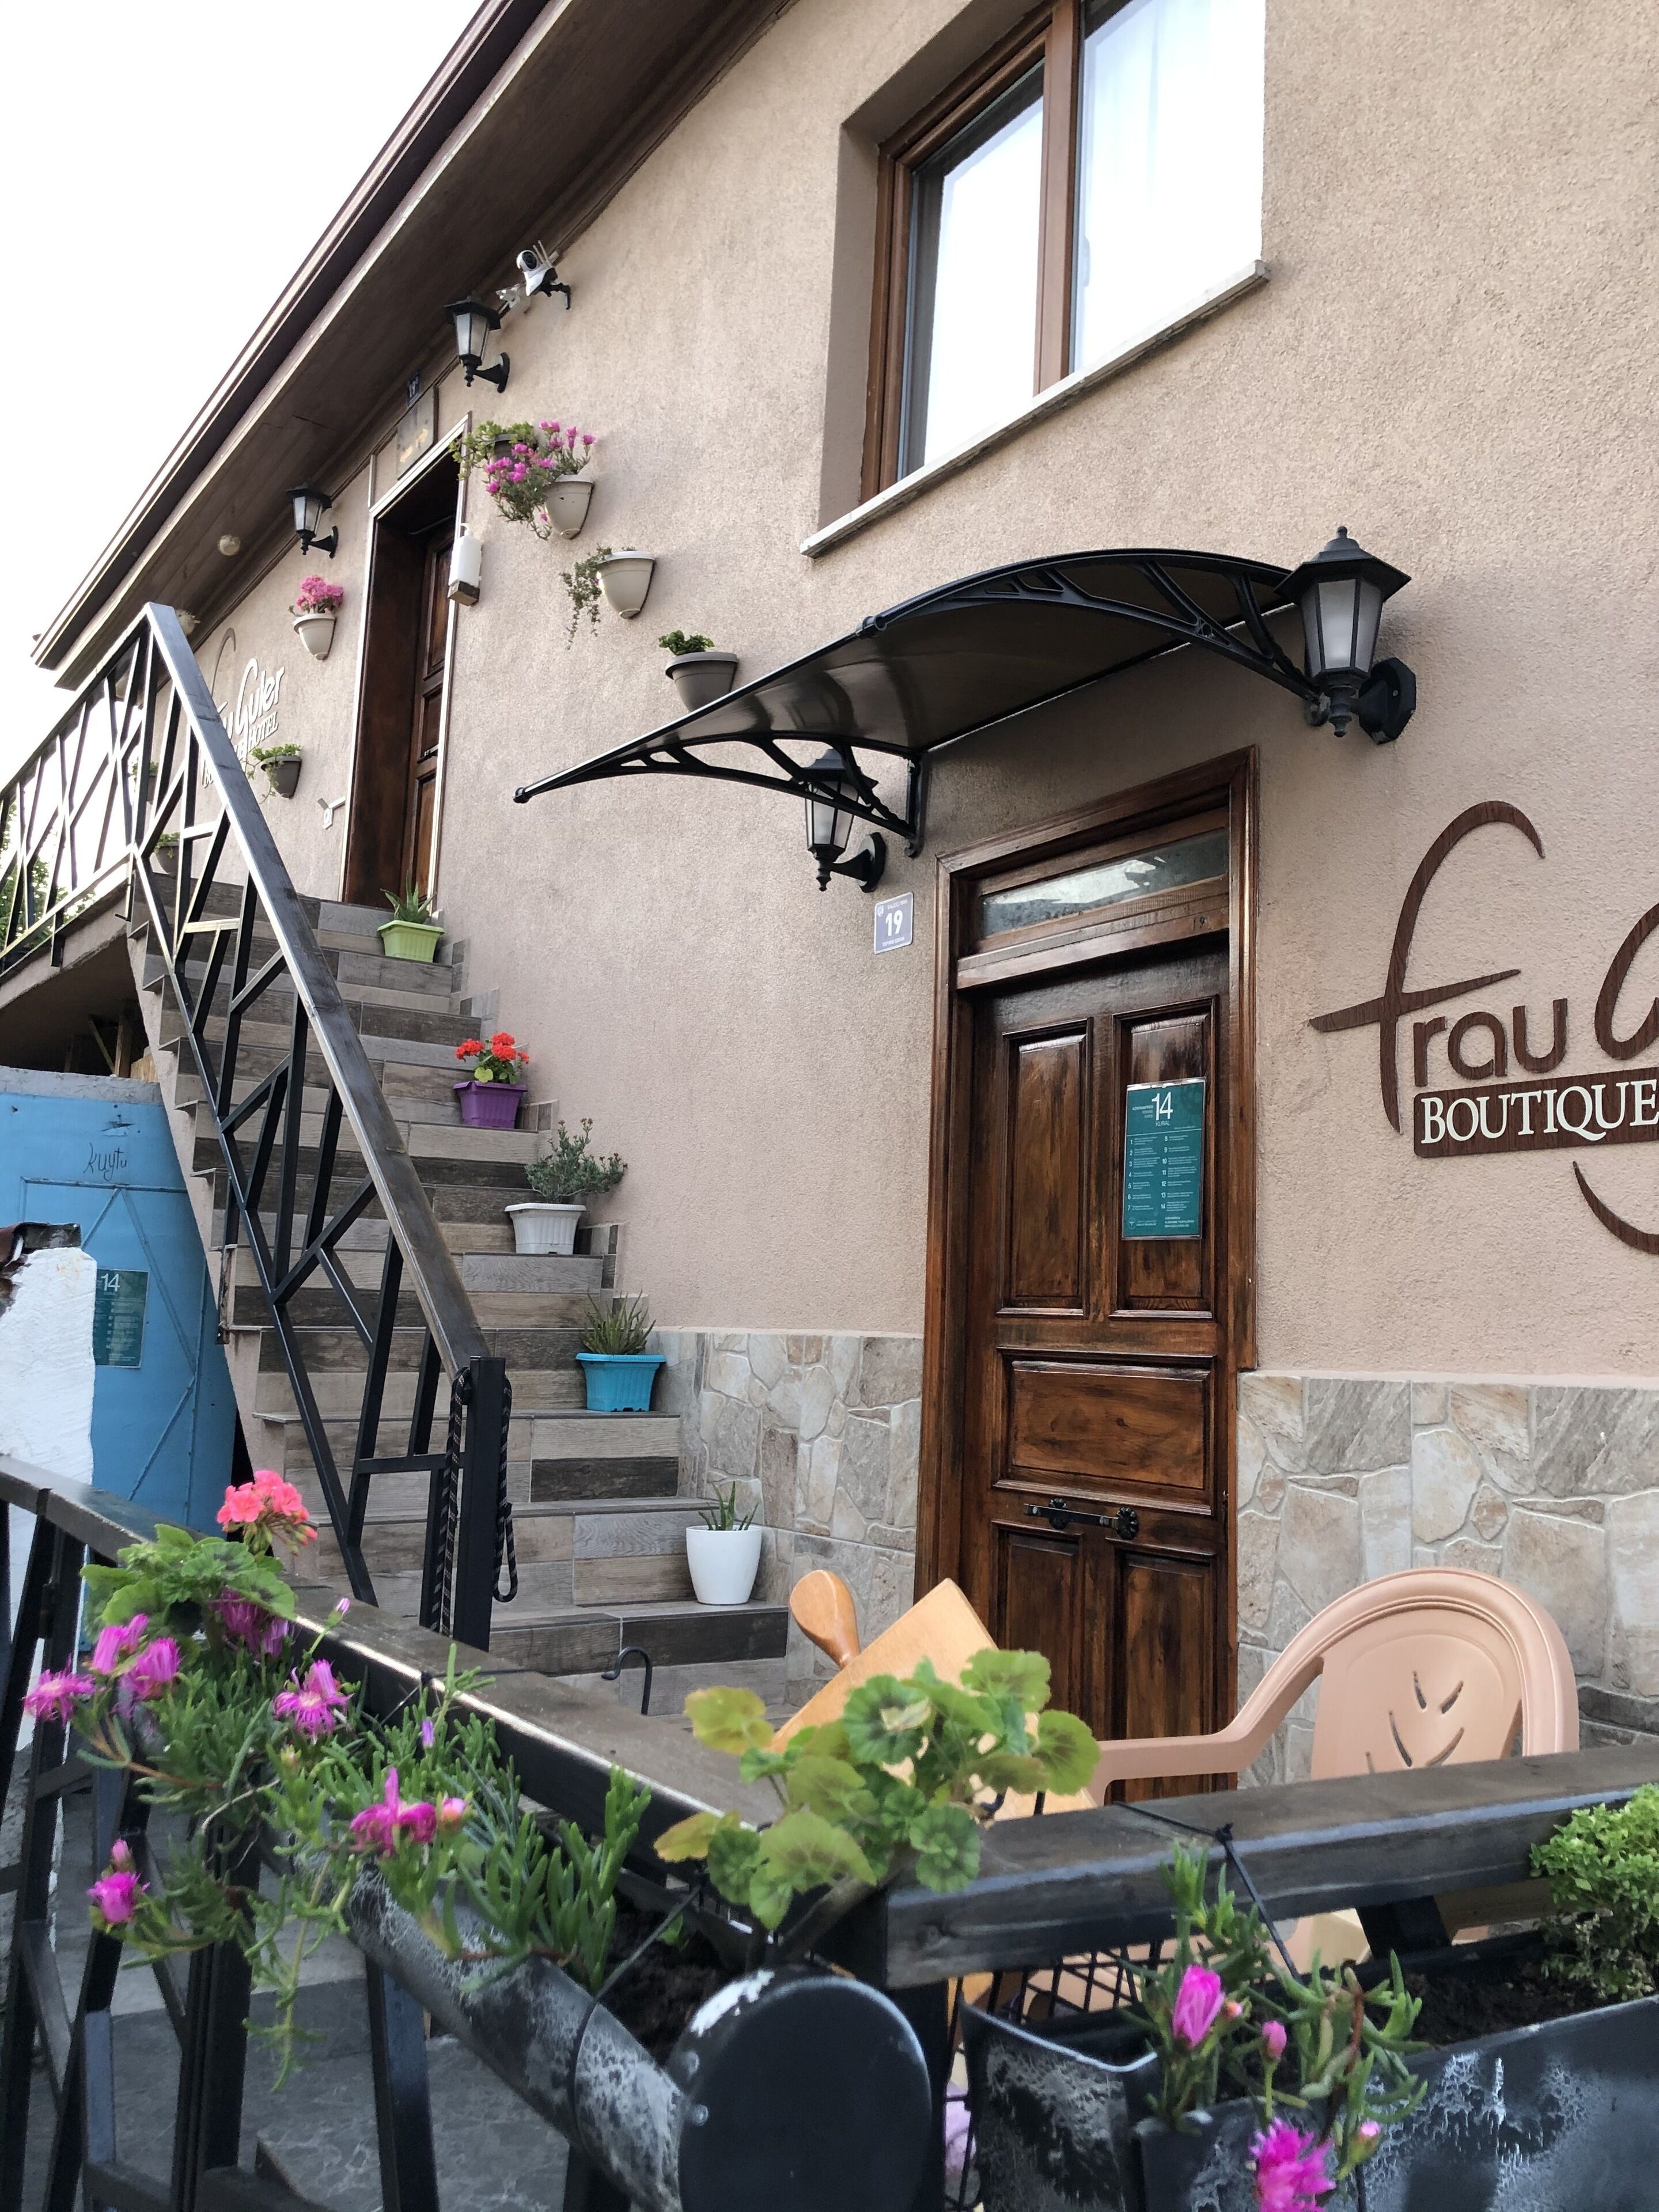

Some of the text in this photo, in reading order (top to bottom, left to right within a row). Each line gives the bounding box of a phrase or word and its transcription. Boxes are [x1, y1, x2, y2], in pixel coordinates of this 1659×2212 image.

[249, 711, 279, 753] HOTEL
[885, 910, 903, 937] 19
[1152, 1092, 1173, 1120] 14
[1421, 1078, 1659, 1145] BOUTIQUE
[101, 1273, 120, 1292] 14
